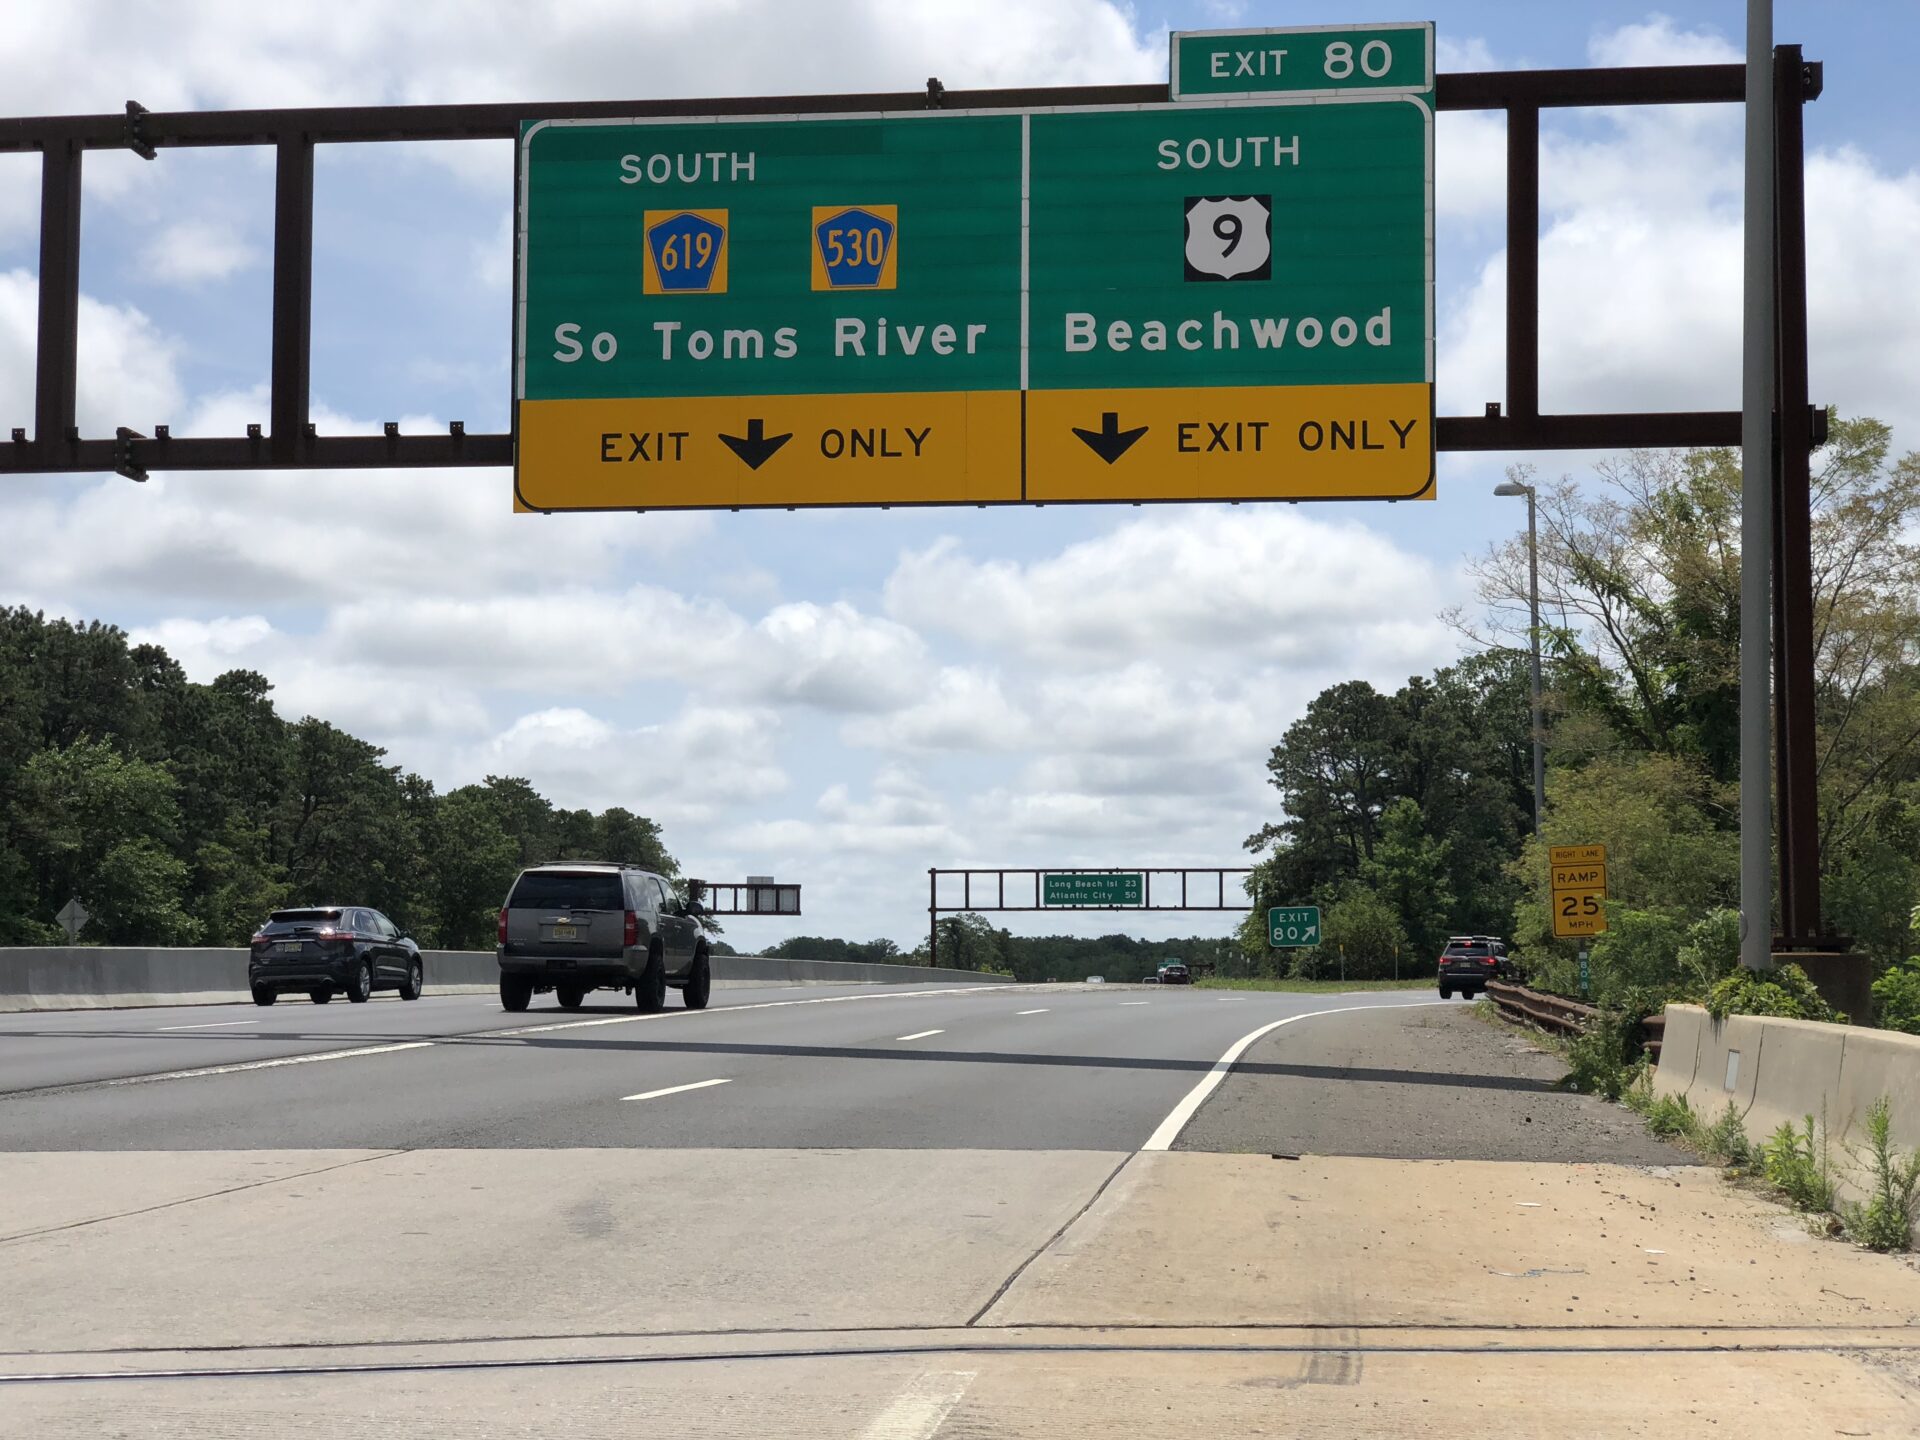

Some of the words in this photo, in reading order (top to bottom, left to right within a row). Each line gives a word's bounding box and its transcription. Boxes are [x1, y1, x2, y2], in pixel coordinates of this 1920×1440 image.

[1210, 50, 1288, 77] EXIT
[1323, 40, 1393, 79] 80
[620, 152, 756, 185] SOUTH
[1157, 135, 1300, 170] SOUTH
[661, 233, 712, 271] 619
[827, 228, 884, 267] 530
[1212, 213, 1243, 259] 9
[553, 322, 617, 363] So
[654, 320, 798, 361] Toms
[835, 317, 987, 357] River
[1065, 306, 1392, 353] Beachwood
[601, 432, 689, 463] EXIT
[820, 427, 932, 459] ONLY
[1178, 421, 1270, 453] EXIT
[1298, 419, 1417, 451] ONLY
[1556, 850, 1576, 859] RIGHT
[1581, 849, 1599, 857] LANE
[1049, 880, 1071, 890] Long
[1075, 880, 1103, 888] Beach
[1557, 871, 1599, 884] RAMP
[1092, 892, 1113, 900] City
[1562, 896, 1599, 917] 25
[1273, 926, 1298, 940] 80
[1279, 912, 1309, 922] EXIT
[1569, 921, 1593, 929] MPH
